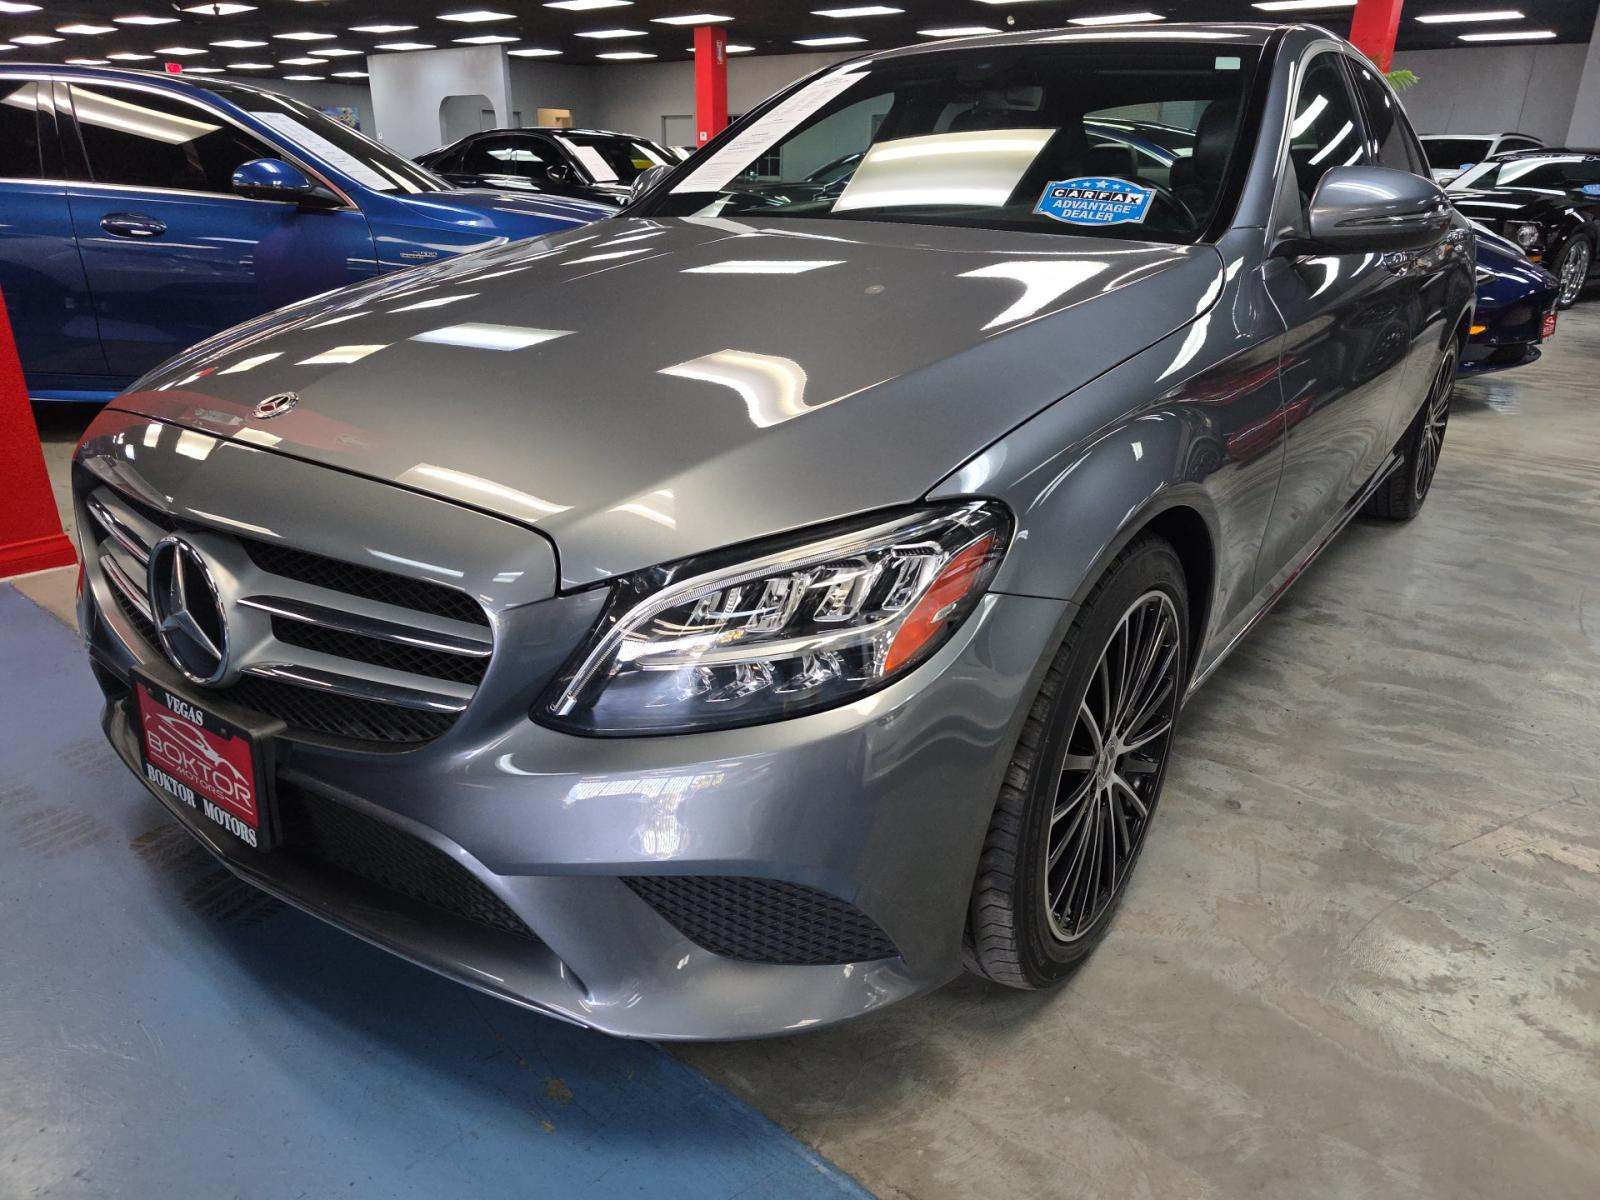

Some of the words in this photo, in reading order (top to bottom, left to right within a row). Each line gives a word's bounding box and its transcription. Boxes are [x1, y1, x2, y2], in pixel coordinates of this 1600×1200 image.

[1052, 199, 1131, 214] ADVANTAGE
[1053, 188, 1142, 204] CARFAX
[1061, 209, 1114, 221] DEALER
[165, 693, 203, 726] VEGAS
[147, 730, 253, 808] BOKTOR
[175, 766, 225, 800] MOTORS
[146, 763, 197, 809] BOKTOR
[202, 798, 258, 848] MOTORS
